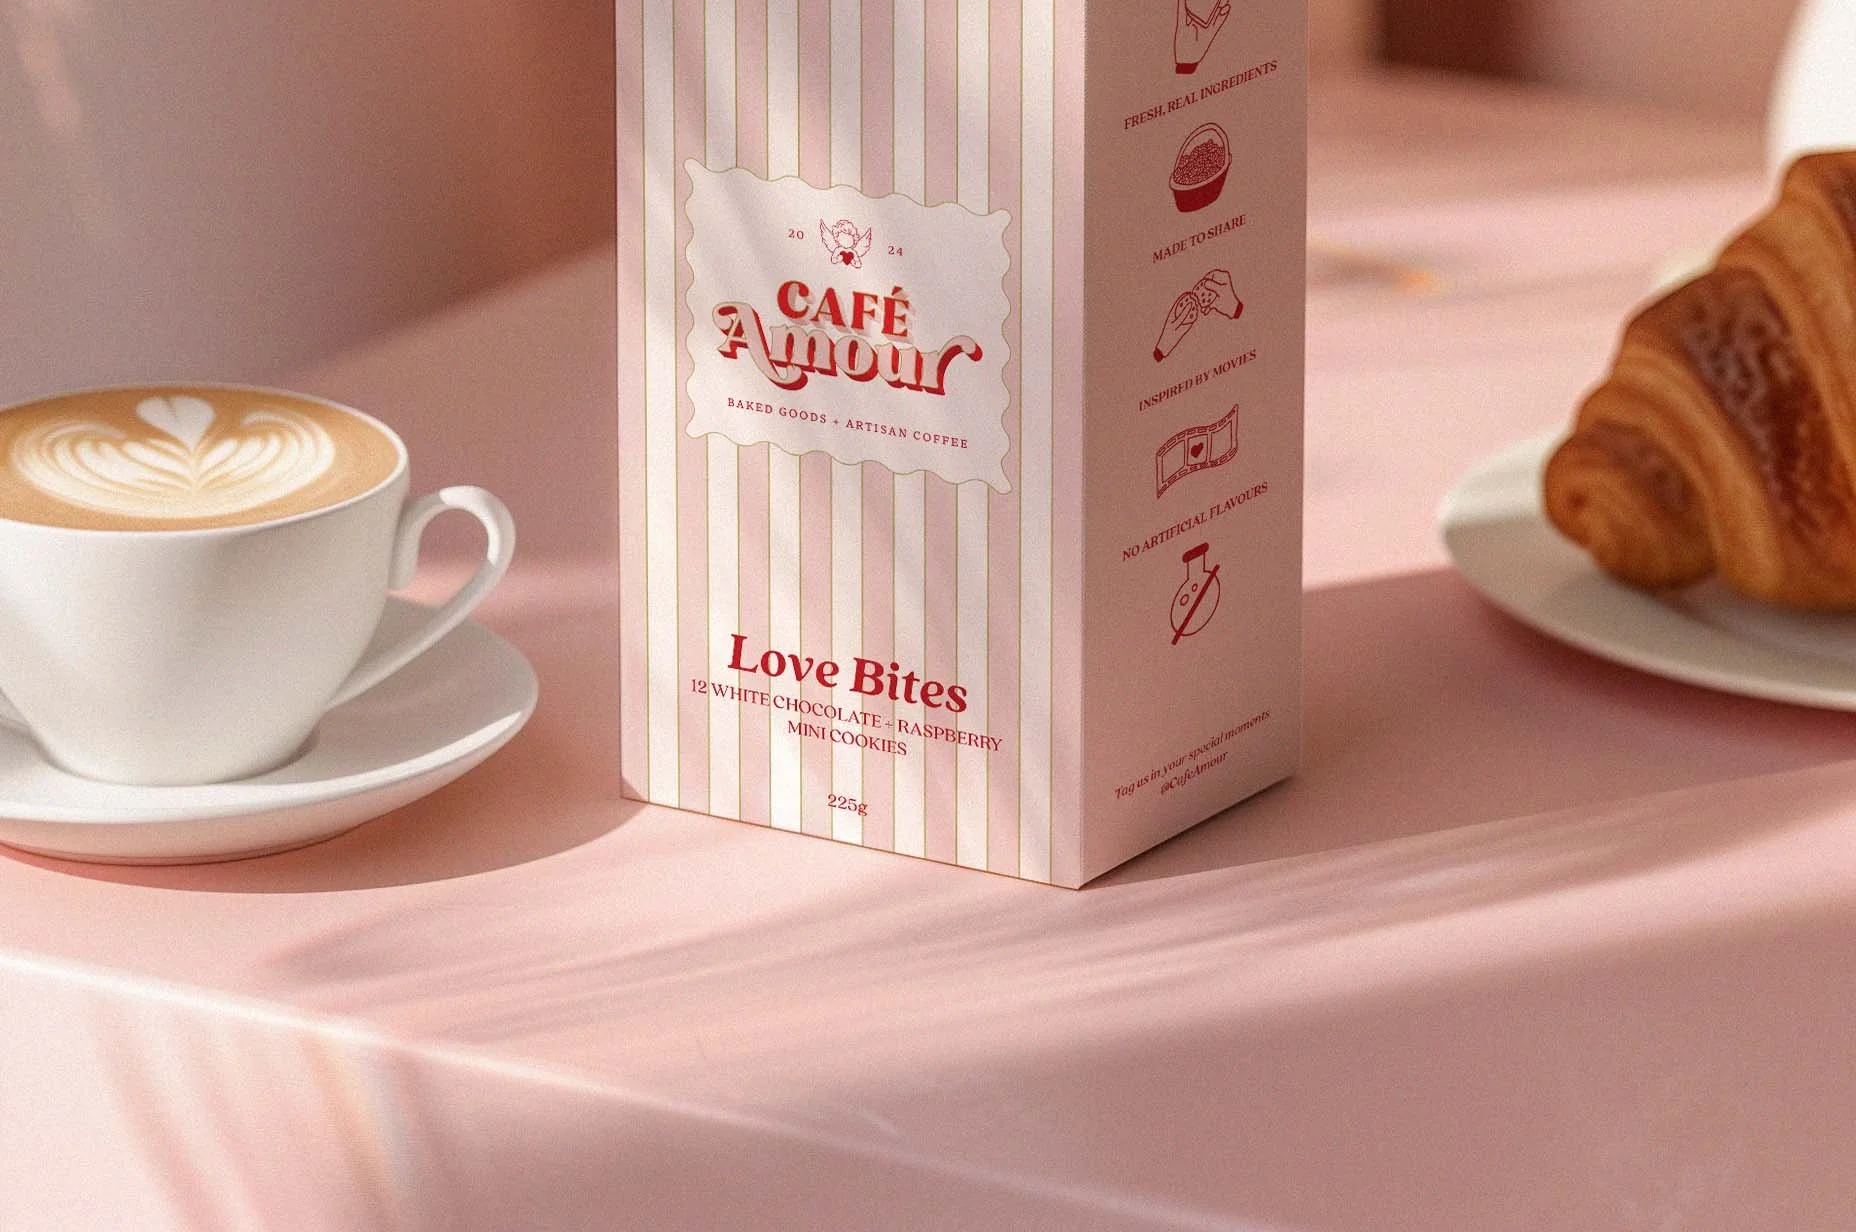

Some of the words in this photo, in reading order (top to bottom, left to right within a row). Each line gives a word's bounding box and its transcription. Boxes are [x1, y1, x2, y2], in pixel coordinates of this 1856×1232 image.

[1123, 103, 1166, 130] FRESH,
[1168, 91, 1198, 113] REAL
[1200, 60, 1278, 100] INGREDIENTS
[788, 229, 805, 240] 20
[888, 245, 904, 256] 24
[1152, 240, 1187, 264] MADE
[1189, 232, 1206, 248] TO
[1207, 214, 1247, 240] SHARE
[777, 280, 912, 338] CAFÉ
[712, 301, 983, 395] Amour
[1138, 377, 1194, 412] INSPIRED
[1195, 369, 1210, 386] BY
[1212, 349, 1257, 378] MOVIES
[728, 397, 774, 415] BAKED
[779, 407, 827, 424] GOODS
[846, 418, 907, 439] ARTISAN
[913, 431, 968, 449] COFFEE
[1122, 544, 1140, 562] NO
[1142, 512, 1208, 553] ARTIFICIAL
[1209, 481, 1268, 519] FLAVOURS
[728, 634, 840, 688] Love
[850, 657, 967, 713] Bites
[691, 679, 707, 694] 12
[711, 682, 770, 706] WHITE
[773, 695, 882, 729] CHOCOLATE
[898, 719, 1003, 752] RASPBERRY
[788, 720, 826, 741] MINI
[830, 728, 907, 756] COOKIES
[1115, 781, 1135, 800] Tag
[1136, 774, 1149, 789] us
[1150, 767, 1161, 781] in
[1161, 753, 1187, 778] your
[1188, 732, 1223, 760] special
[1224, 710, 1271, 741] moments
[827, 793, 868, 817] 225g
